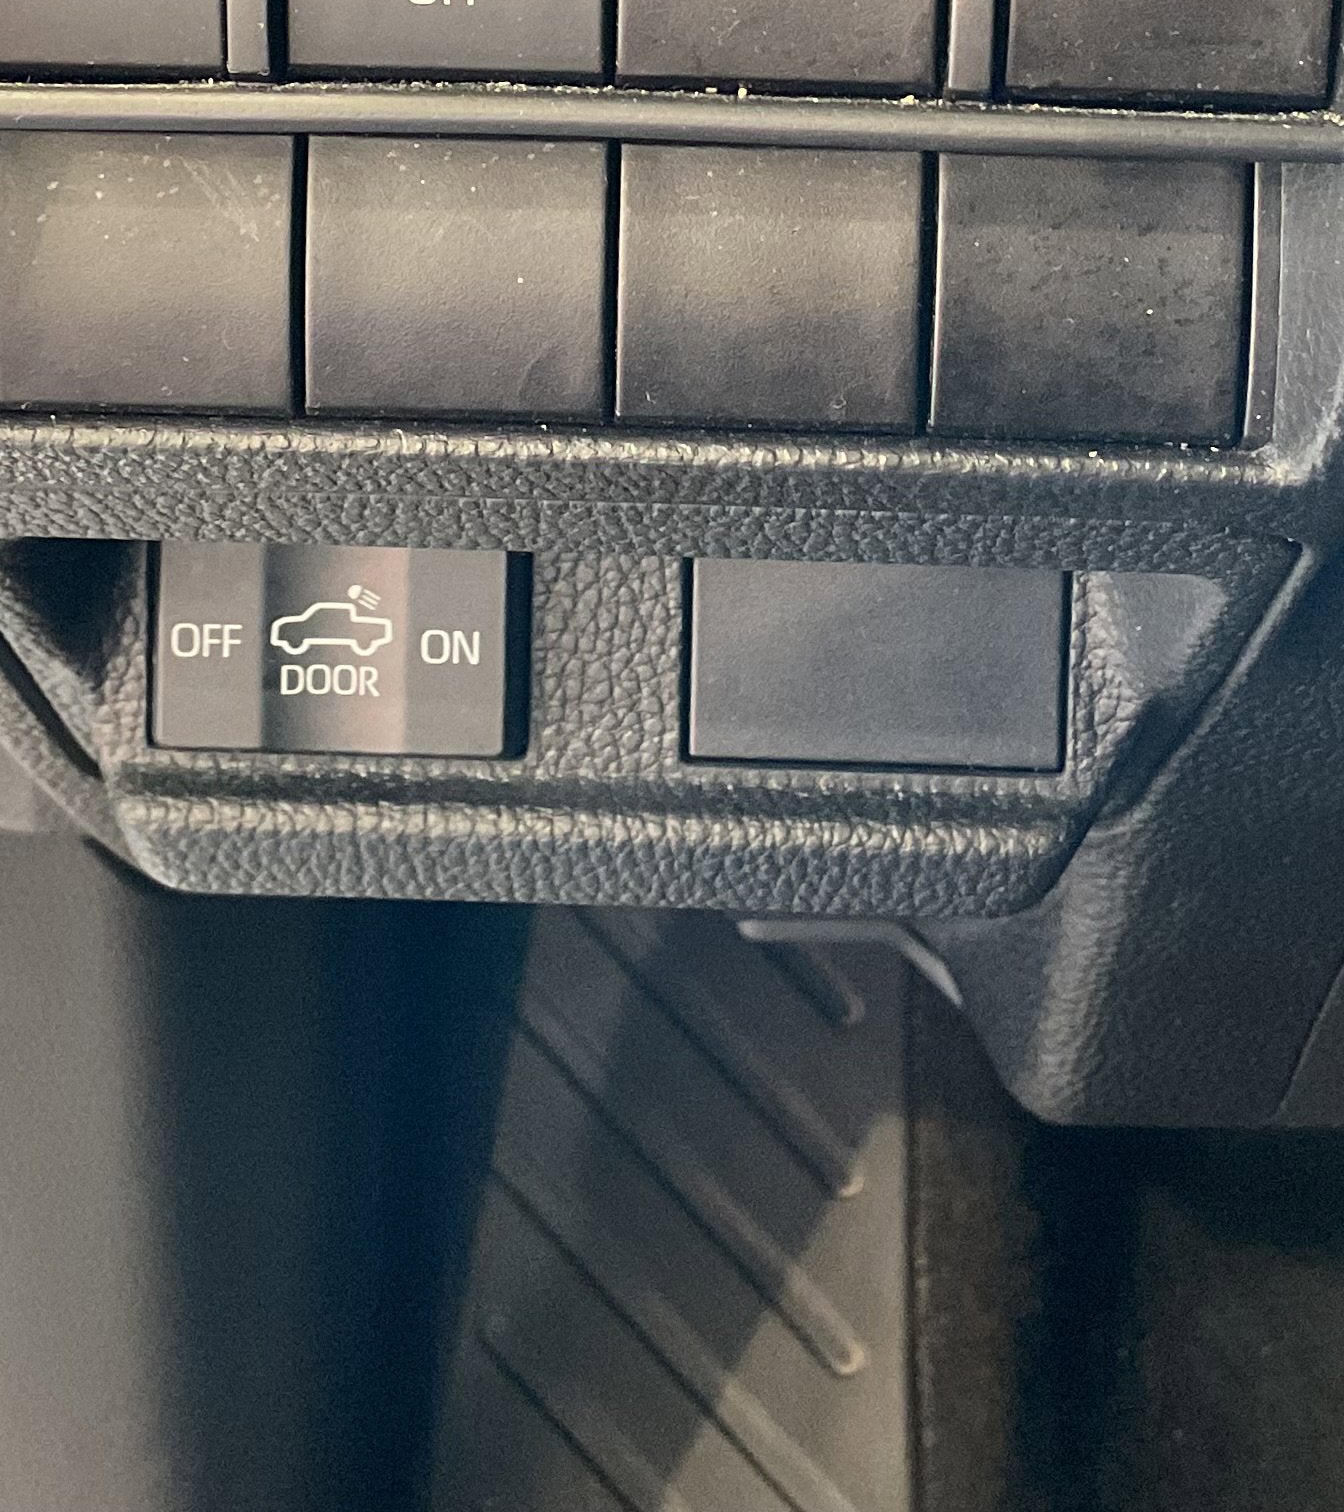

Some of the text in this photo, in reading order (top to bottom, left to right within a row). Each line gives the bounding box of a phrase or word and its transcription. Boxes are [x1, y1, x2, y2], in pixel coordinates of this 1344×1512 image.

[170, 622, 243, 658] OFF
[420, 629, 480, 665] ON
[280, 664, 380, 697] DOOR
